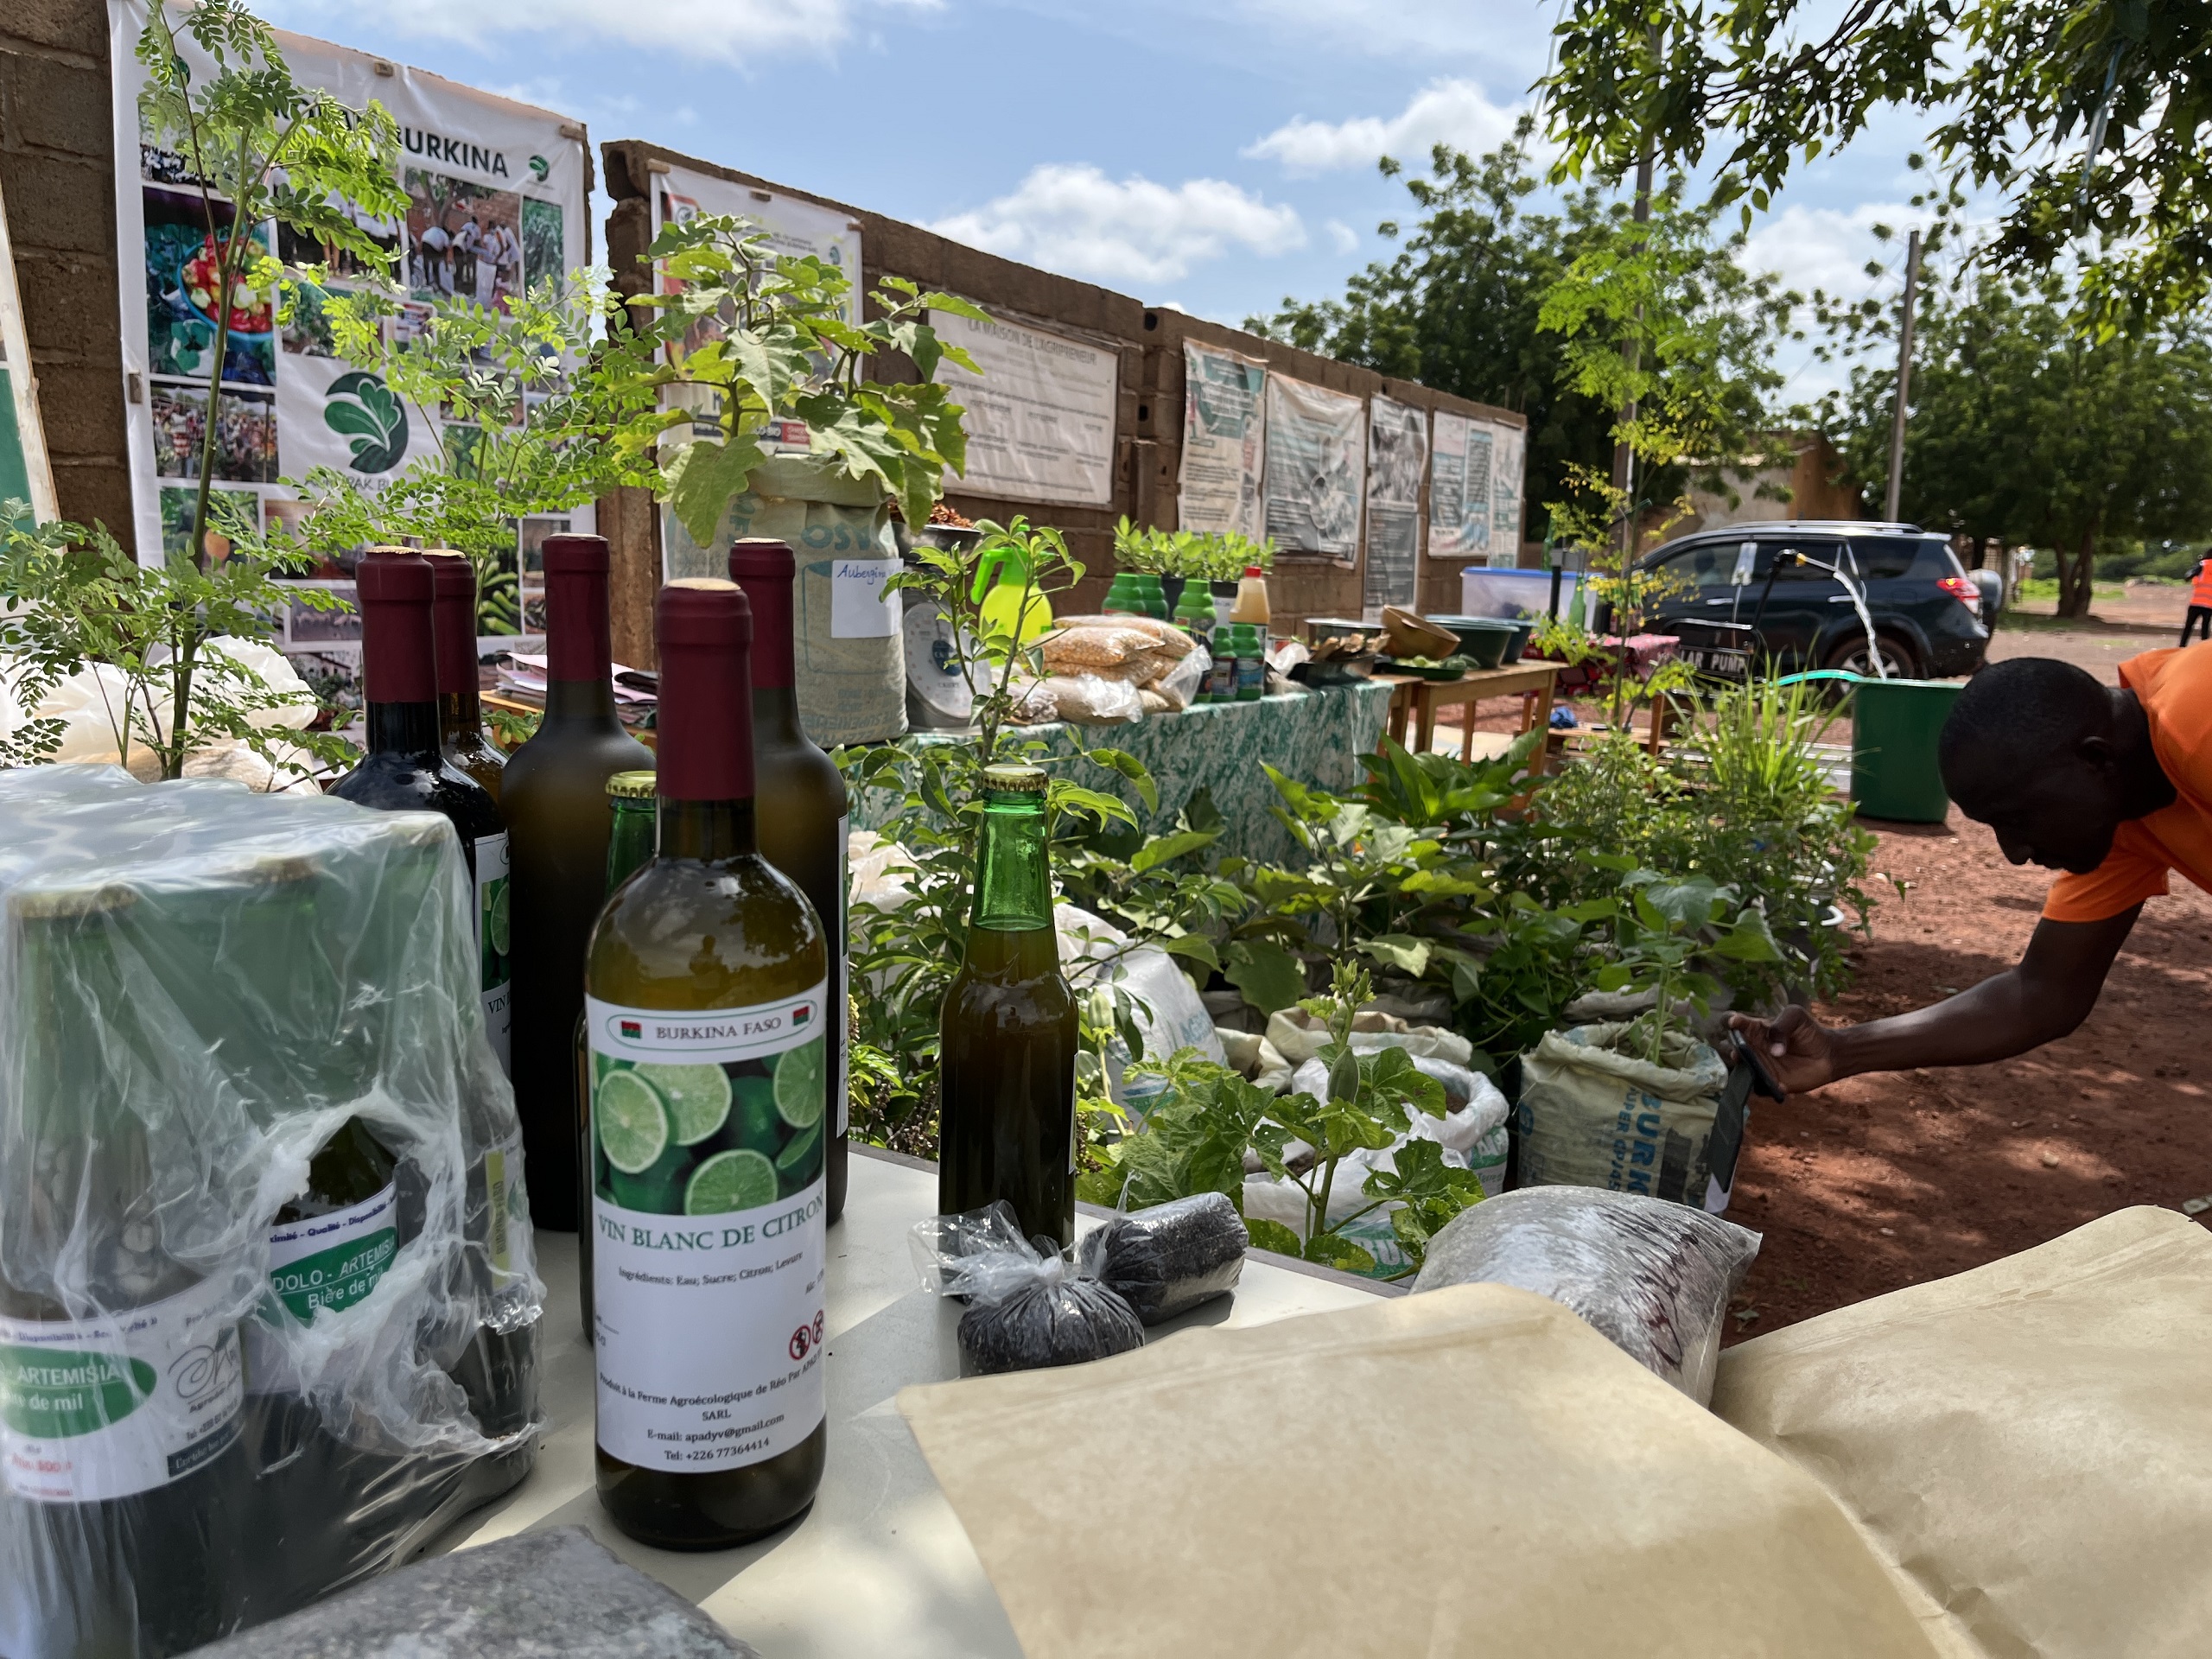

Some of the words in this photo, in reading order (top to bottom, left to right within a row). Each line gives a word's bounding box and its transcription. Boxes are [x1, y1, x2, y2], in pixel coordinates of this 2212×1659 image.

[1711, 652, 1746, 672] PUMP
[487, 995, 506, 1014] VIN
[656, 1025, 738, 1039] BURKINA
[743, 1016, 782, 1035] FASO
[307, 1220, 341, 1237] Qualité
[597, 1212, 627, 1243] VIN
[631, 1226, 715, 1252] BLANC
[721, 1224, 756, 1248] DE
[761, 1190, 823, 1238] CITRON
[272, 1268, 324, 1293] DOLO
[349, 1278, 366, 1296] de
[17, 1363, 122, 1386] ARTEMISIA
[28, 1392, 50, 1411] de
[54, 1392, 84, 1411] mil
[628, 1387, 636, 1399] la
[637, 1390, 668, 1405] Ferme
[670, 1389, 753, 1408] Agroécologique
[755, 1383, 768, 1396] de
[702, 1408, 732, 1422] SARL
[647, 1428, 683, 1442] E-mail:
[685, 1414, 785, 1444] apadyv@gmail.com
[664, 1450, 683, 1461] Tel:
[686, 1449, 714, 1461] +226
[715, 1437, 770, 1459] 77364414
